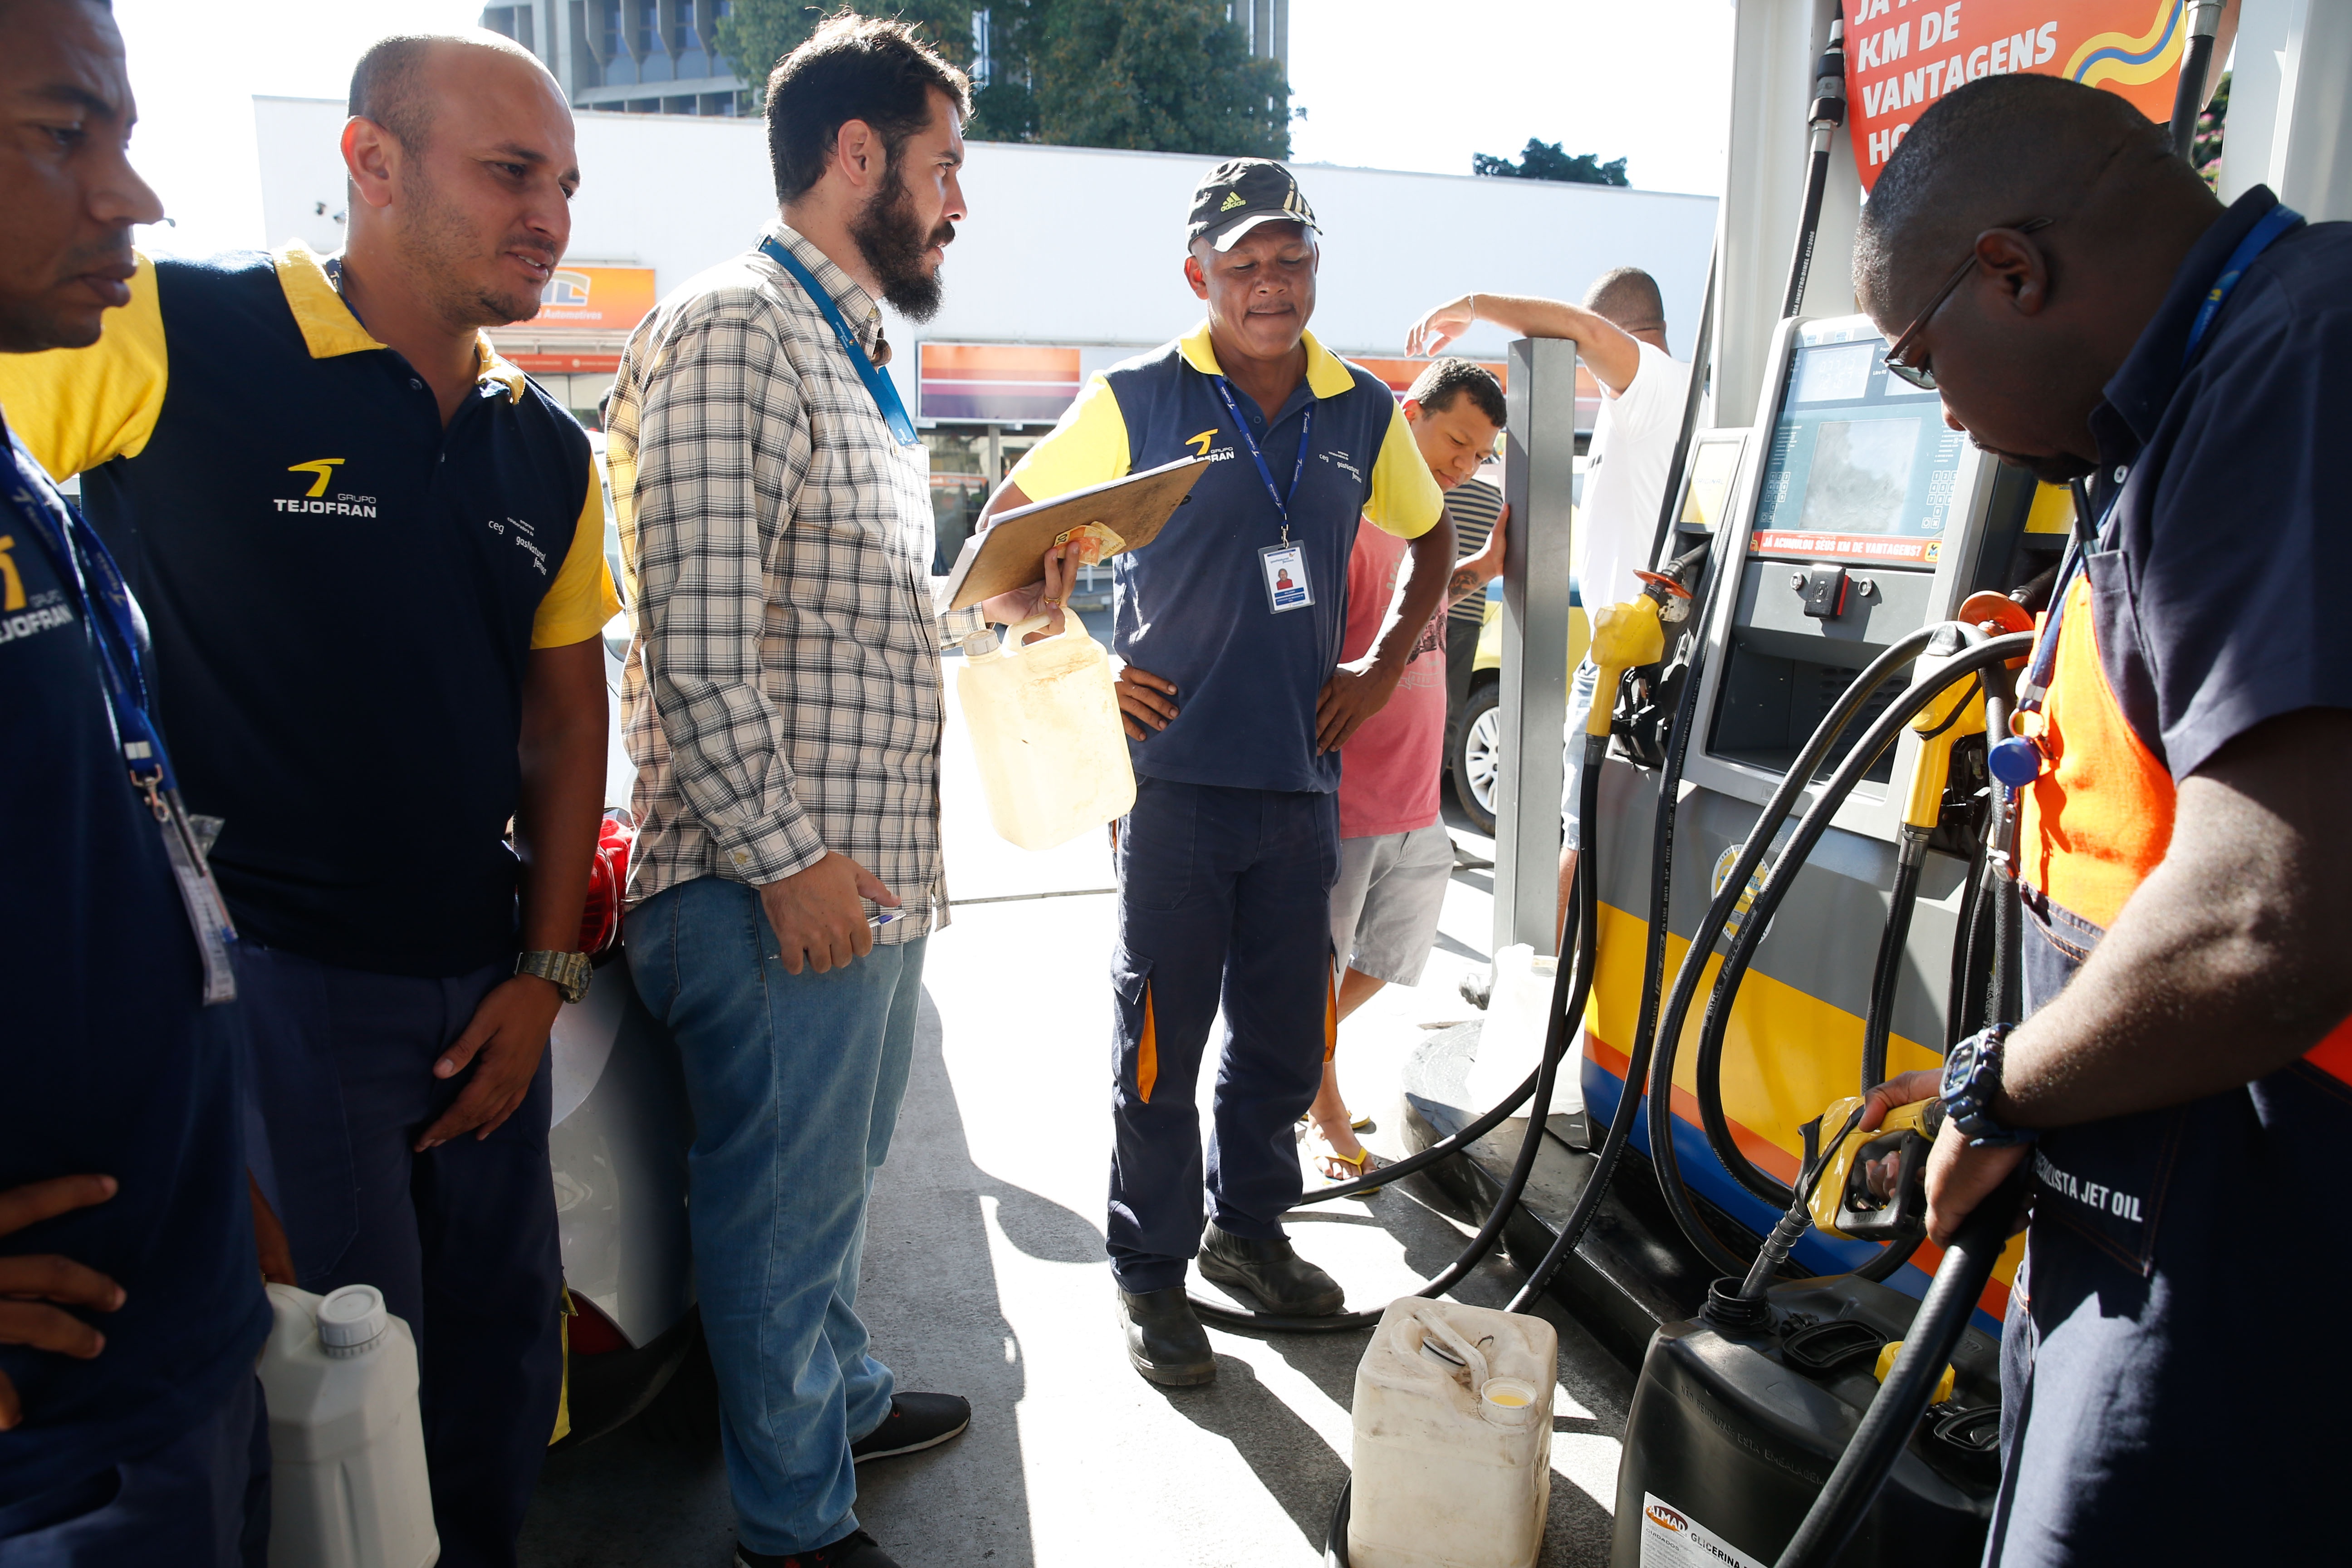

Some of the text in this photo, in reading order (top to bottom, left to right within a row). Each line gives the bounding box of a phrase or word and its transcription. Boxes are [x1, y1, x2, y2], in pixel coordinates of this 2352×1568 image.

[1857, 1, 1962, 73] KM DE
[1862, 21, 2058, 119] VANTAGENS
[1220, 199, 1247, 212] adidas
[1319, 454, 1329, 463] ceg
[1337, 461, 1359, 475] gasNatural
[274, 499, 377, 518] TEJOFRAN
[338, 493, 377, 504] GRUPO
[489, 521, 505, 534] ceg
[516, 536, 546, 562] gasNatural
[1763, 535, 1773, 547] JÁ
[1774, 538, 1813, 550] ACUMULOU
[1837, 541, 1850, 552] KM
[1852, 542, 1863, 553] DE
[1865, 543, 1922, 557] VANTAGENS?
[533, 557, 547, 575] fenosa
[1708, 984, 1722, 1017] BALFLEX
[2080, 1181, 2109, 1210] JET
[2111, 1191, 2143, 1223] OIL
[1696, 1398, 1735, 1438] REUTILIZAR
[1737, 1432, 1760, 1455] ESTA
[1648, 1504, 1686, 1532] ALMAD
[1690, 1533, 1740, 1568] GLICERINA
